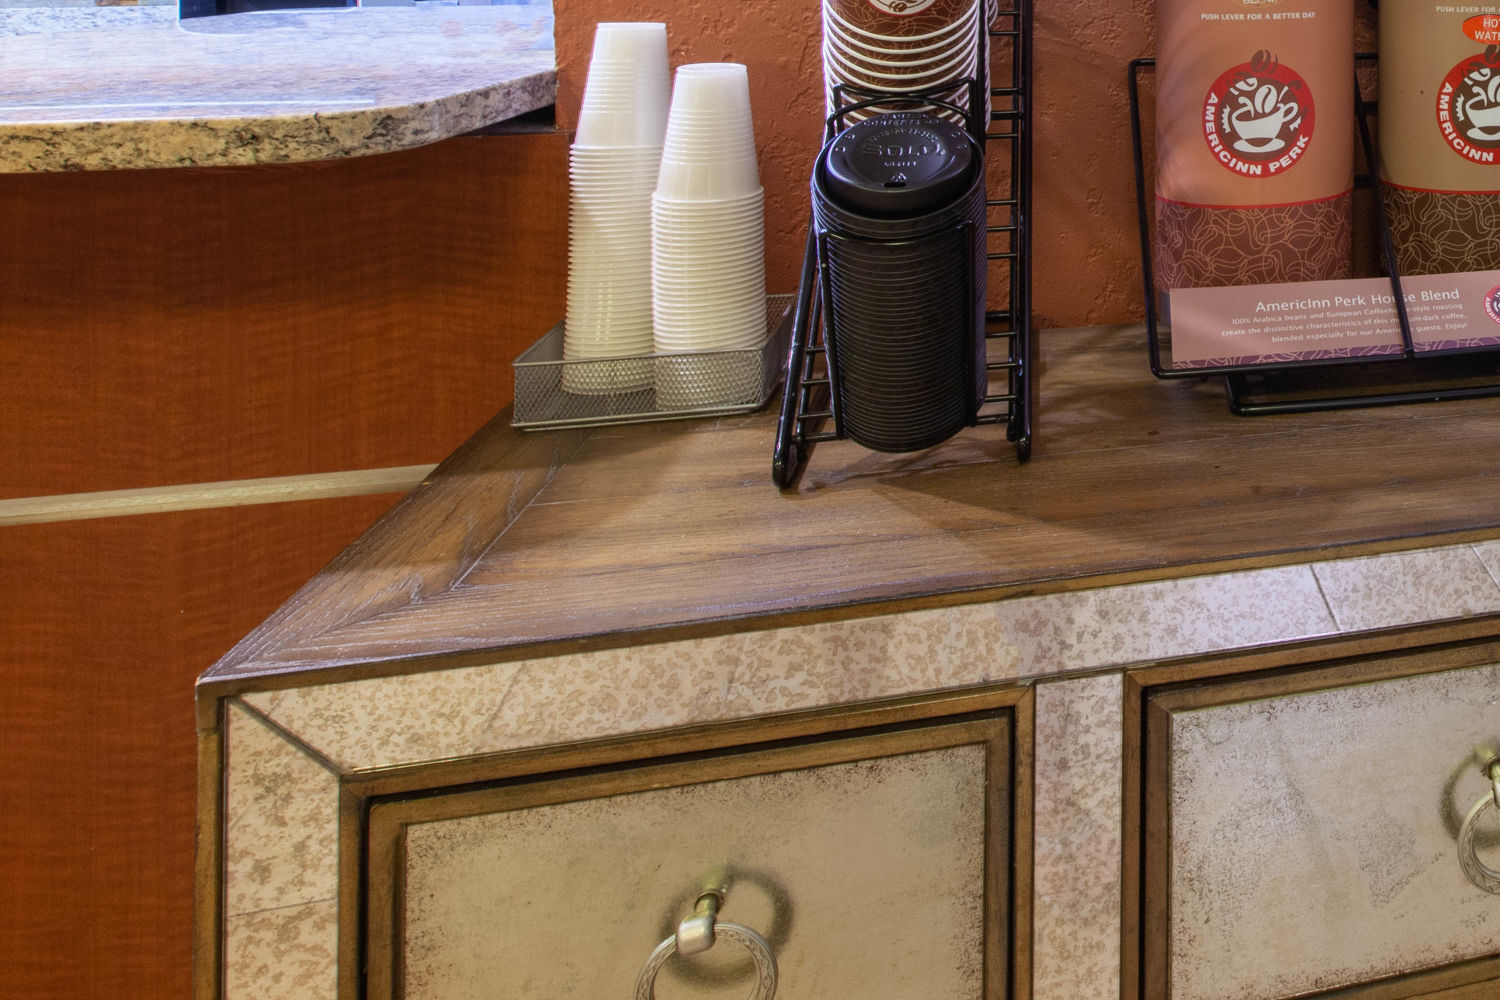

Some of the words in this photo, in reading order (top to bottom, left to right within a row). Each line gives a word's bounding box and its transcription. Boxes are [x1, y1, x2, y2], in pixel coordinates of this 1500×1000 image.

[1201, 13, 1219, 21] PUSH
[1221, 13, 1245, 21] LEVER
[1273, 12, 1300, 20] BETTER
[1204, 91, 1262, 175] AMERICINN
[1268, 133, 1309, 173] PERK
[1439, 82, 1494, 162] AMERICINN
[1255, 299, 1331, 312] AmericInn
[1334, 295, 1367, 307] Perk
[1420, 288, 1460, 302] Blend
[1221, 329, 1246, 337] create
[1263, 324, 1304, 333] distinctive
[1306, 320, 1362, 330] characteristics
[1441, 312, 1467, 320] coffee.
[1253, 315, 1282, 324] Arabica
[1284, 314, 1307, 322] beans
[1326, 310, 1362, 319] European
[1271, 334, 1304, 343] blended
[1306, 331, 1344, 340] especially
[1416, 325, 1443, 333] guests.
[1444, 322, 1467, 331] Enjoy!
